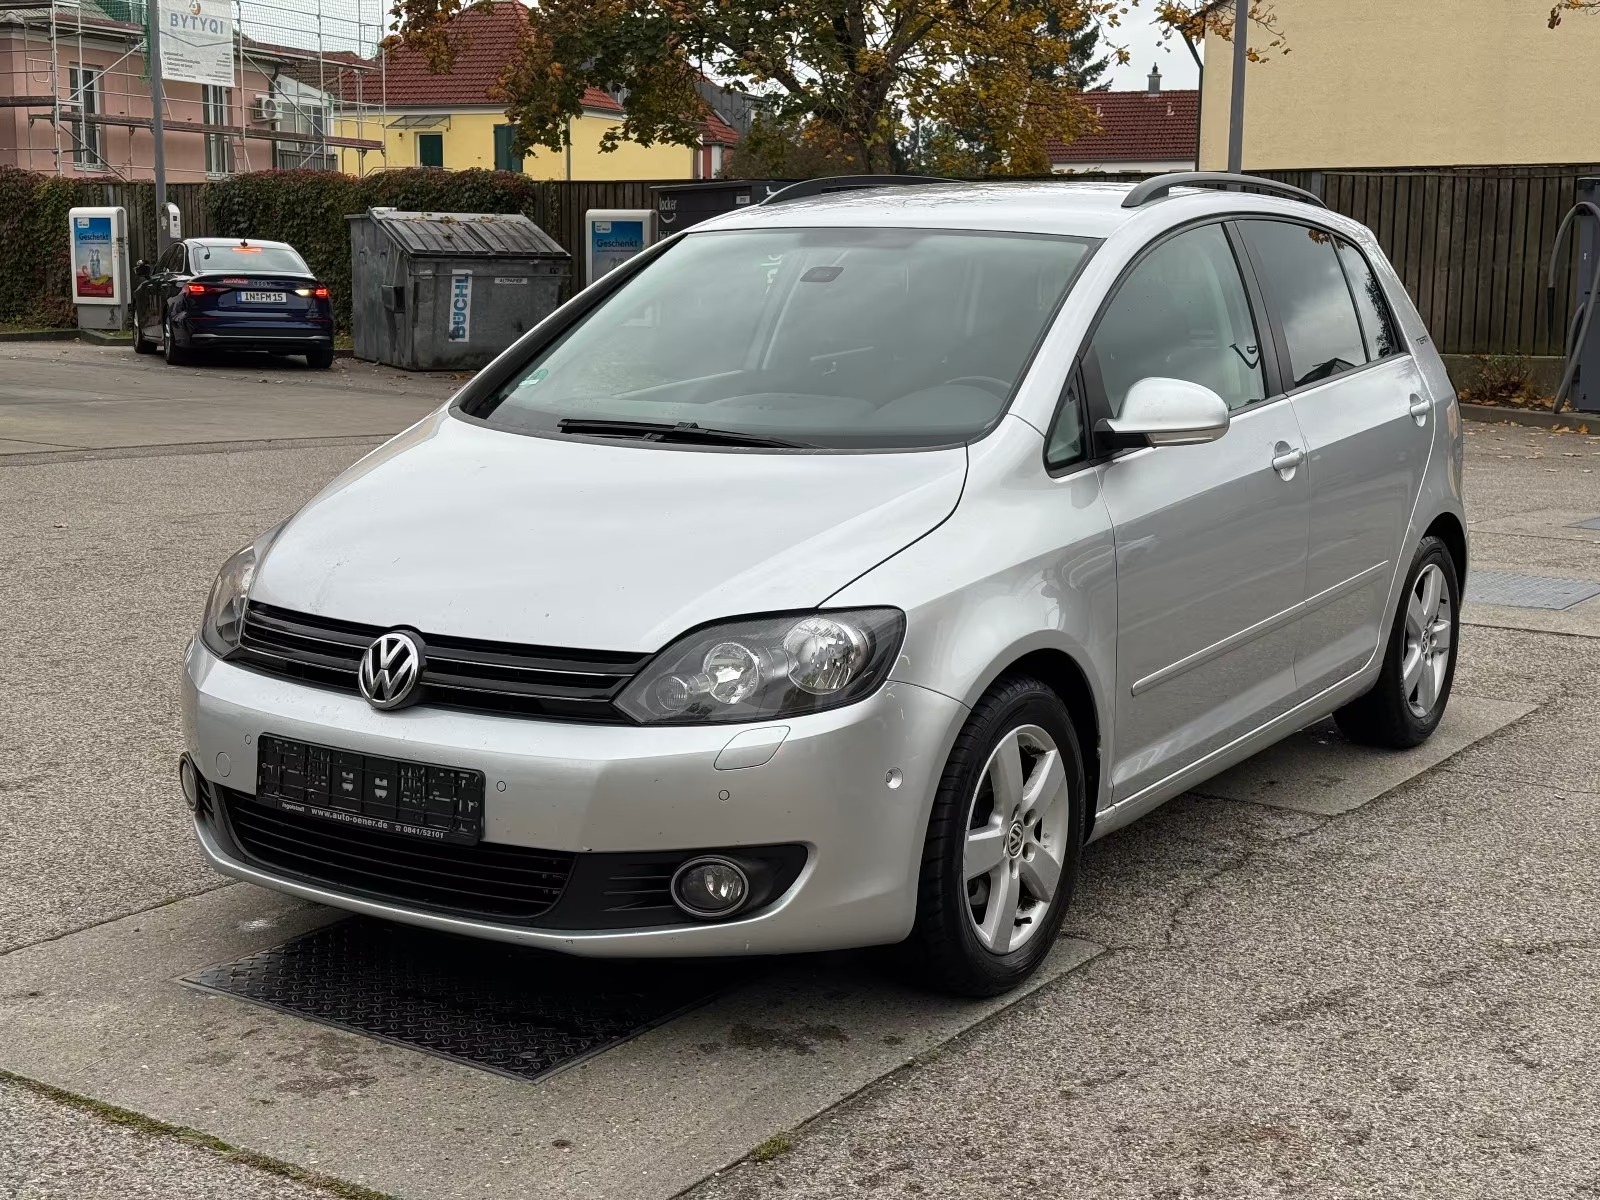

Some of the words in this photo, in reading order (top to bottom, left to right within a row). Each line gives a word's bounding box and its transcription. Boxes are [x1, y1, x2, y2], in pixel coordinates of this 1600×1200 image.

[170, 12, 224, 35] BYTYQI
[659, 197, 677, 211] locker
[79, 232, 109, 241] Geschenkt
[596, 237, 638, 248] Geschenkt
[452, 273, 469, 339] BÜCHL
[311, 807, 388, 830] www.auto-oener.de
[403, 825, 444, 840] 0841/52101
